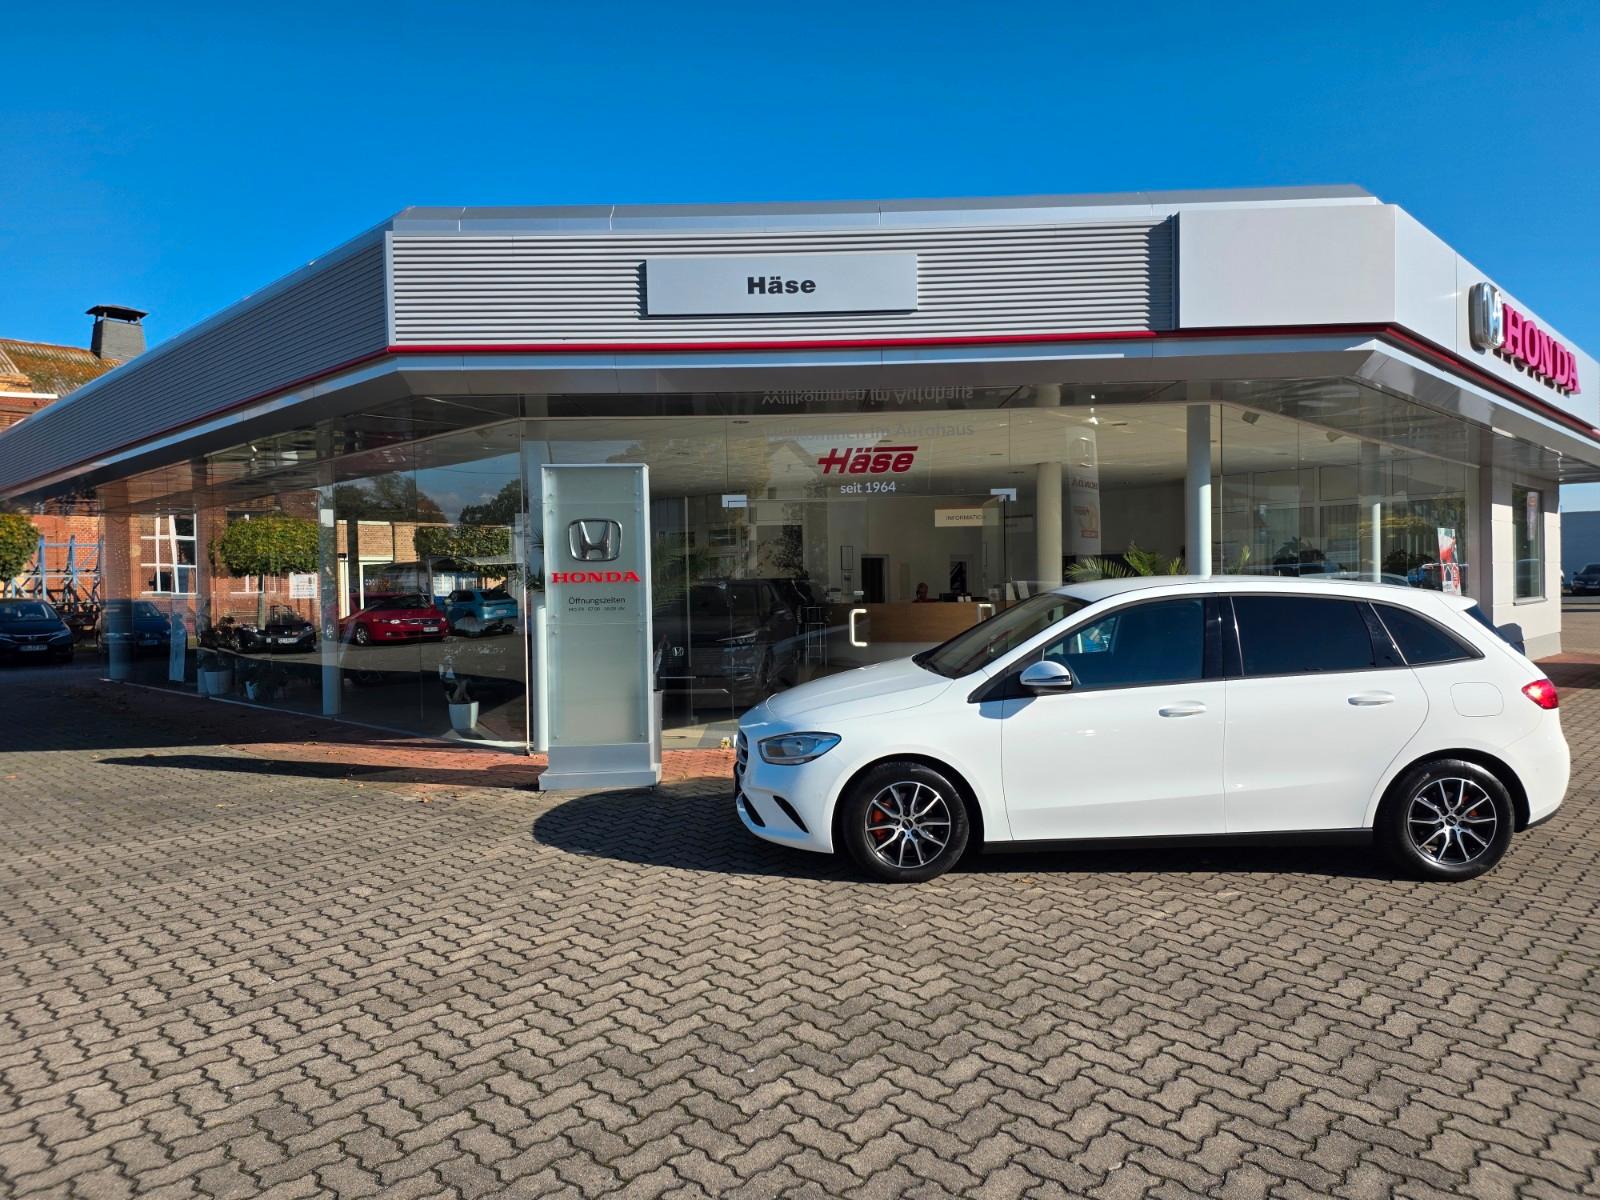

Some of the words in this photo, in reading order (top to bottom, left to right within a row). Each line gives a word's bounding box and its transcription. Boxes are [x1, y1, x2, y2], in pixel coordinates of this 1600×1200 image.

[747, 276, 816, 295] Häse
[1501, 303, 1581, 395] HONDA
[894, 422, 976, 438] Autohaus
[817, 445, 919, 475] Häse
[840, 482, 863, 494] seit
[865, 481, 897, 493] 1964
[551, 571, 640, 584] HONDA
[568, 596, 626, 606] Öffnungszeiten
